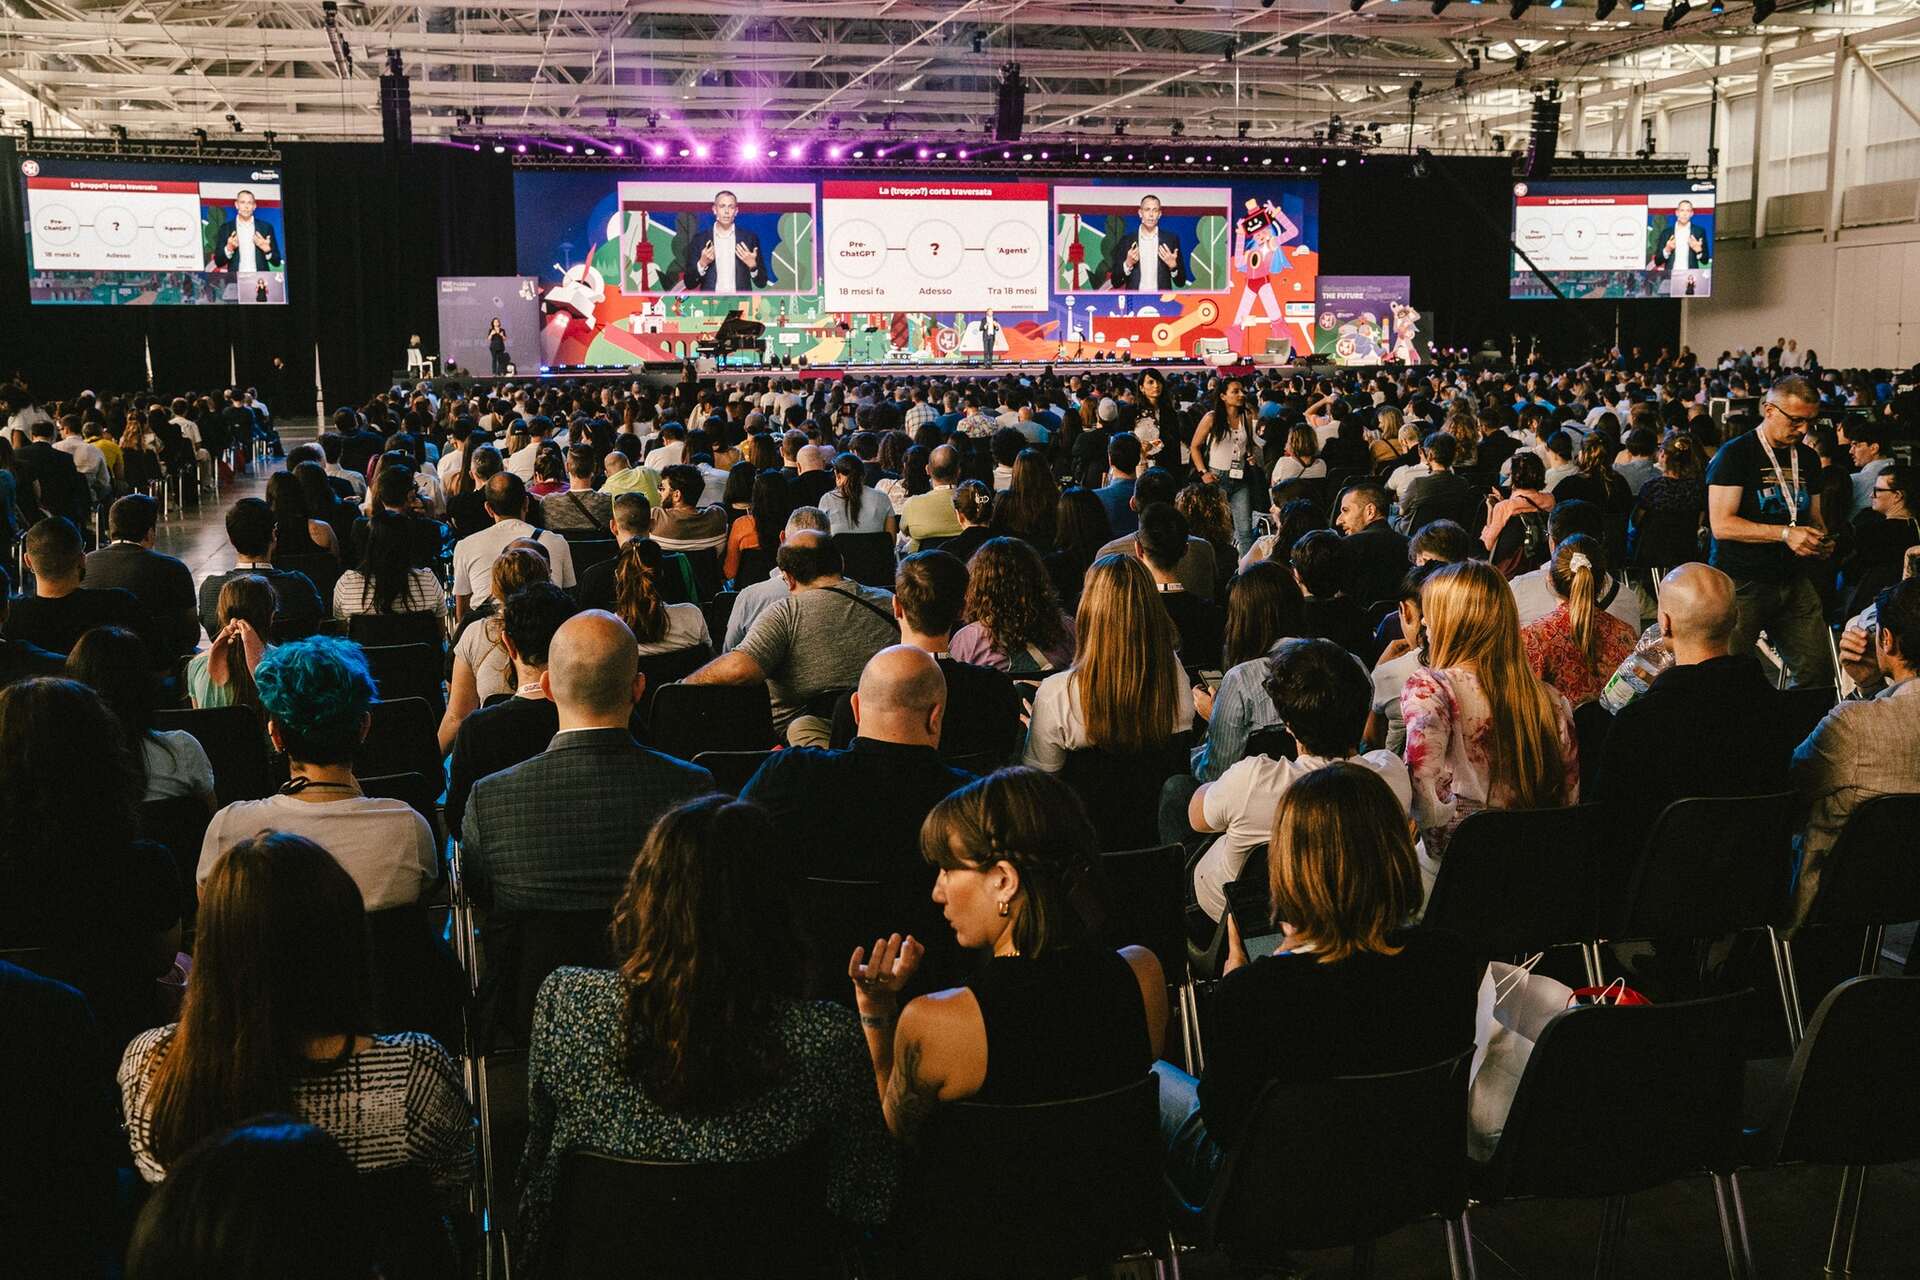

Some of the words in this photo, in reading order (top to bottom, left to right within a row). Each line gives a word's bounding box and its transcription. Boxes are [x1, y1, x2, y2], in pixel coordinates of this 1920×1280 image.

[879, 187, 889, 195] La
[890, 186, 928, 197] (troppo?)
[929, 188, 951, 196] corta
[951, 188, 993, 196] traversata
[112, 221, 120, 231] ?
[930, 242, 940, 256] ?
[839, 287, 849, 296] 18
[850, 287, 874, 296] mesi
[875, 287, 885, 296] fa
[919, 287, 952, 295] Adesso
[988, 287, 1002, 295] Tra
[1004, 287, 1014, 295] 18
[1015, 286, 1037, 295] mesi
